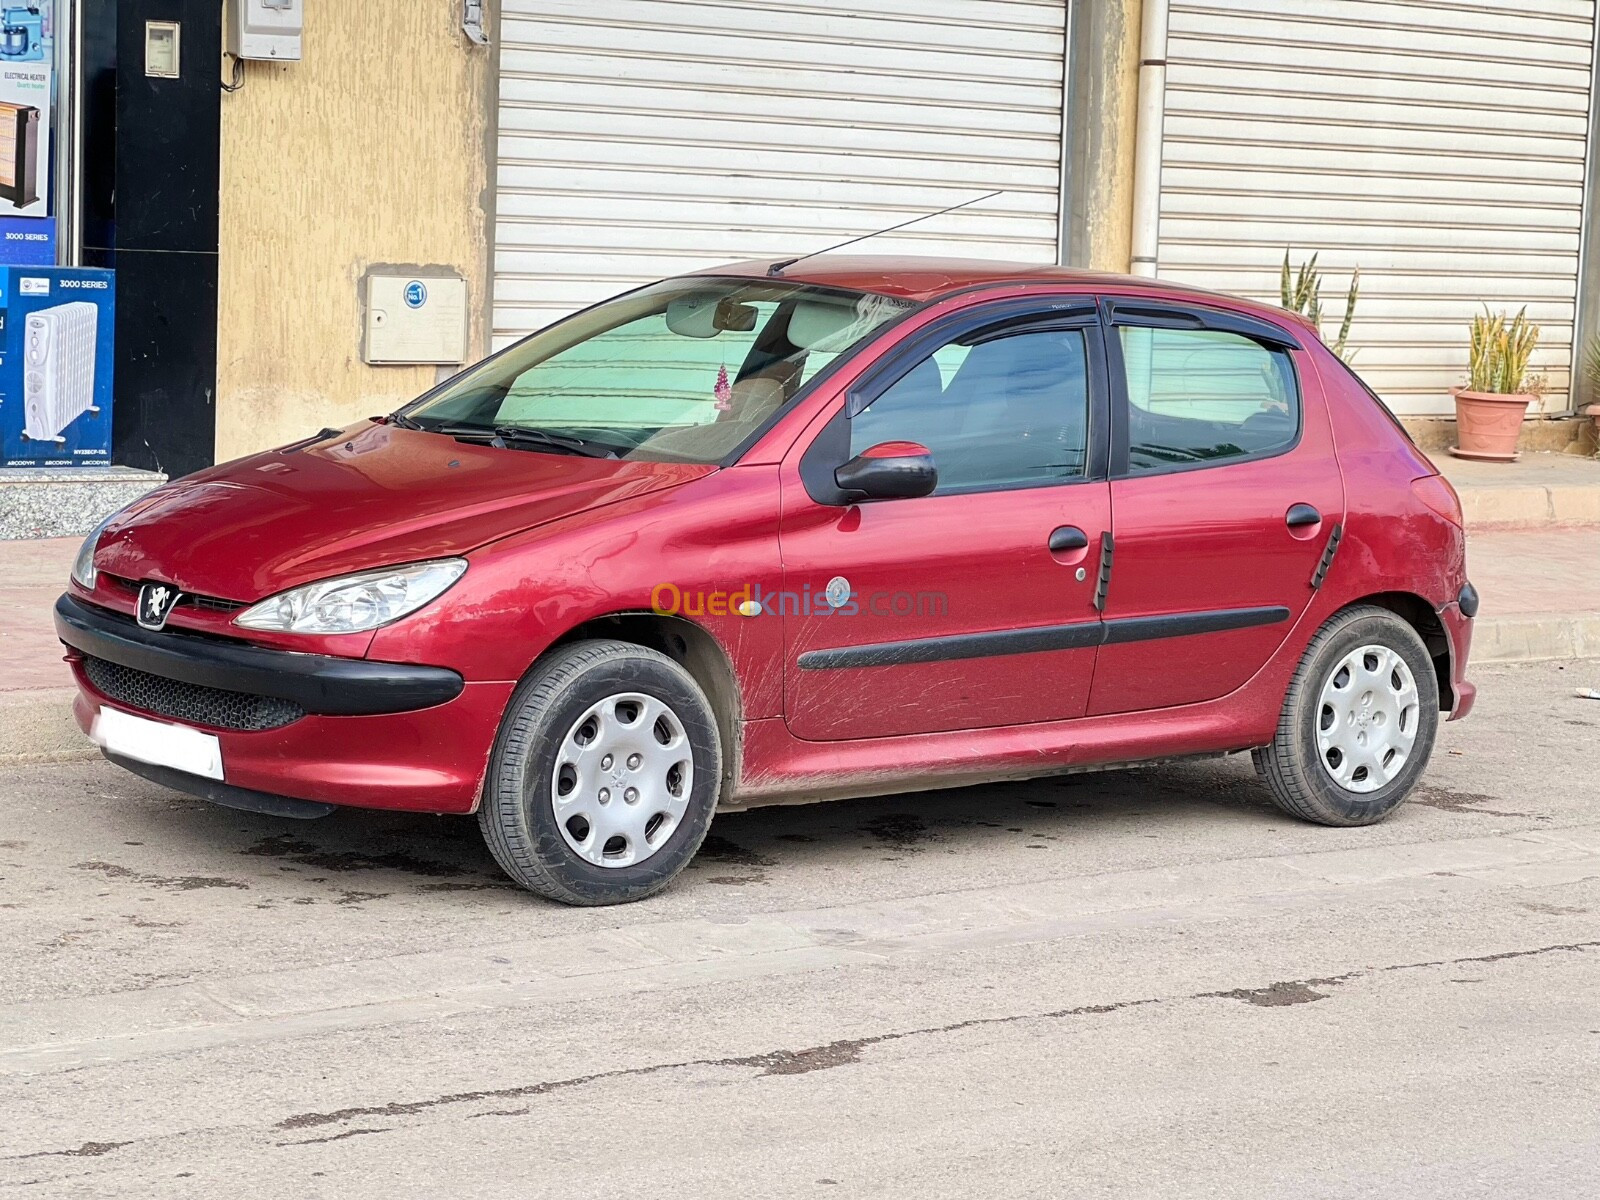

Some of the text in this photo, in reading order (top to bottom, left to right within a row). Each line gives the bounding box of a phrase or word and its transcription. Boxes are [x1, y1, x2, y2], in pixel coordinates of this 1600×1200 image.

[4, 72, 46, 82] ELECTRICAL HEATER
[5, 232, 49, 241] 3000 SERIES
[59, 279, 108, 289] 3000 SERIES
